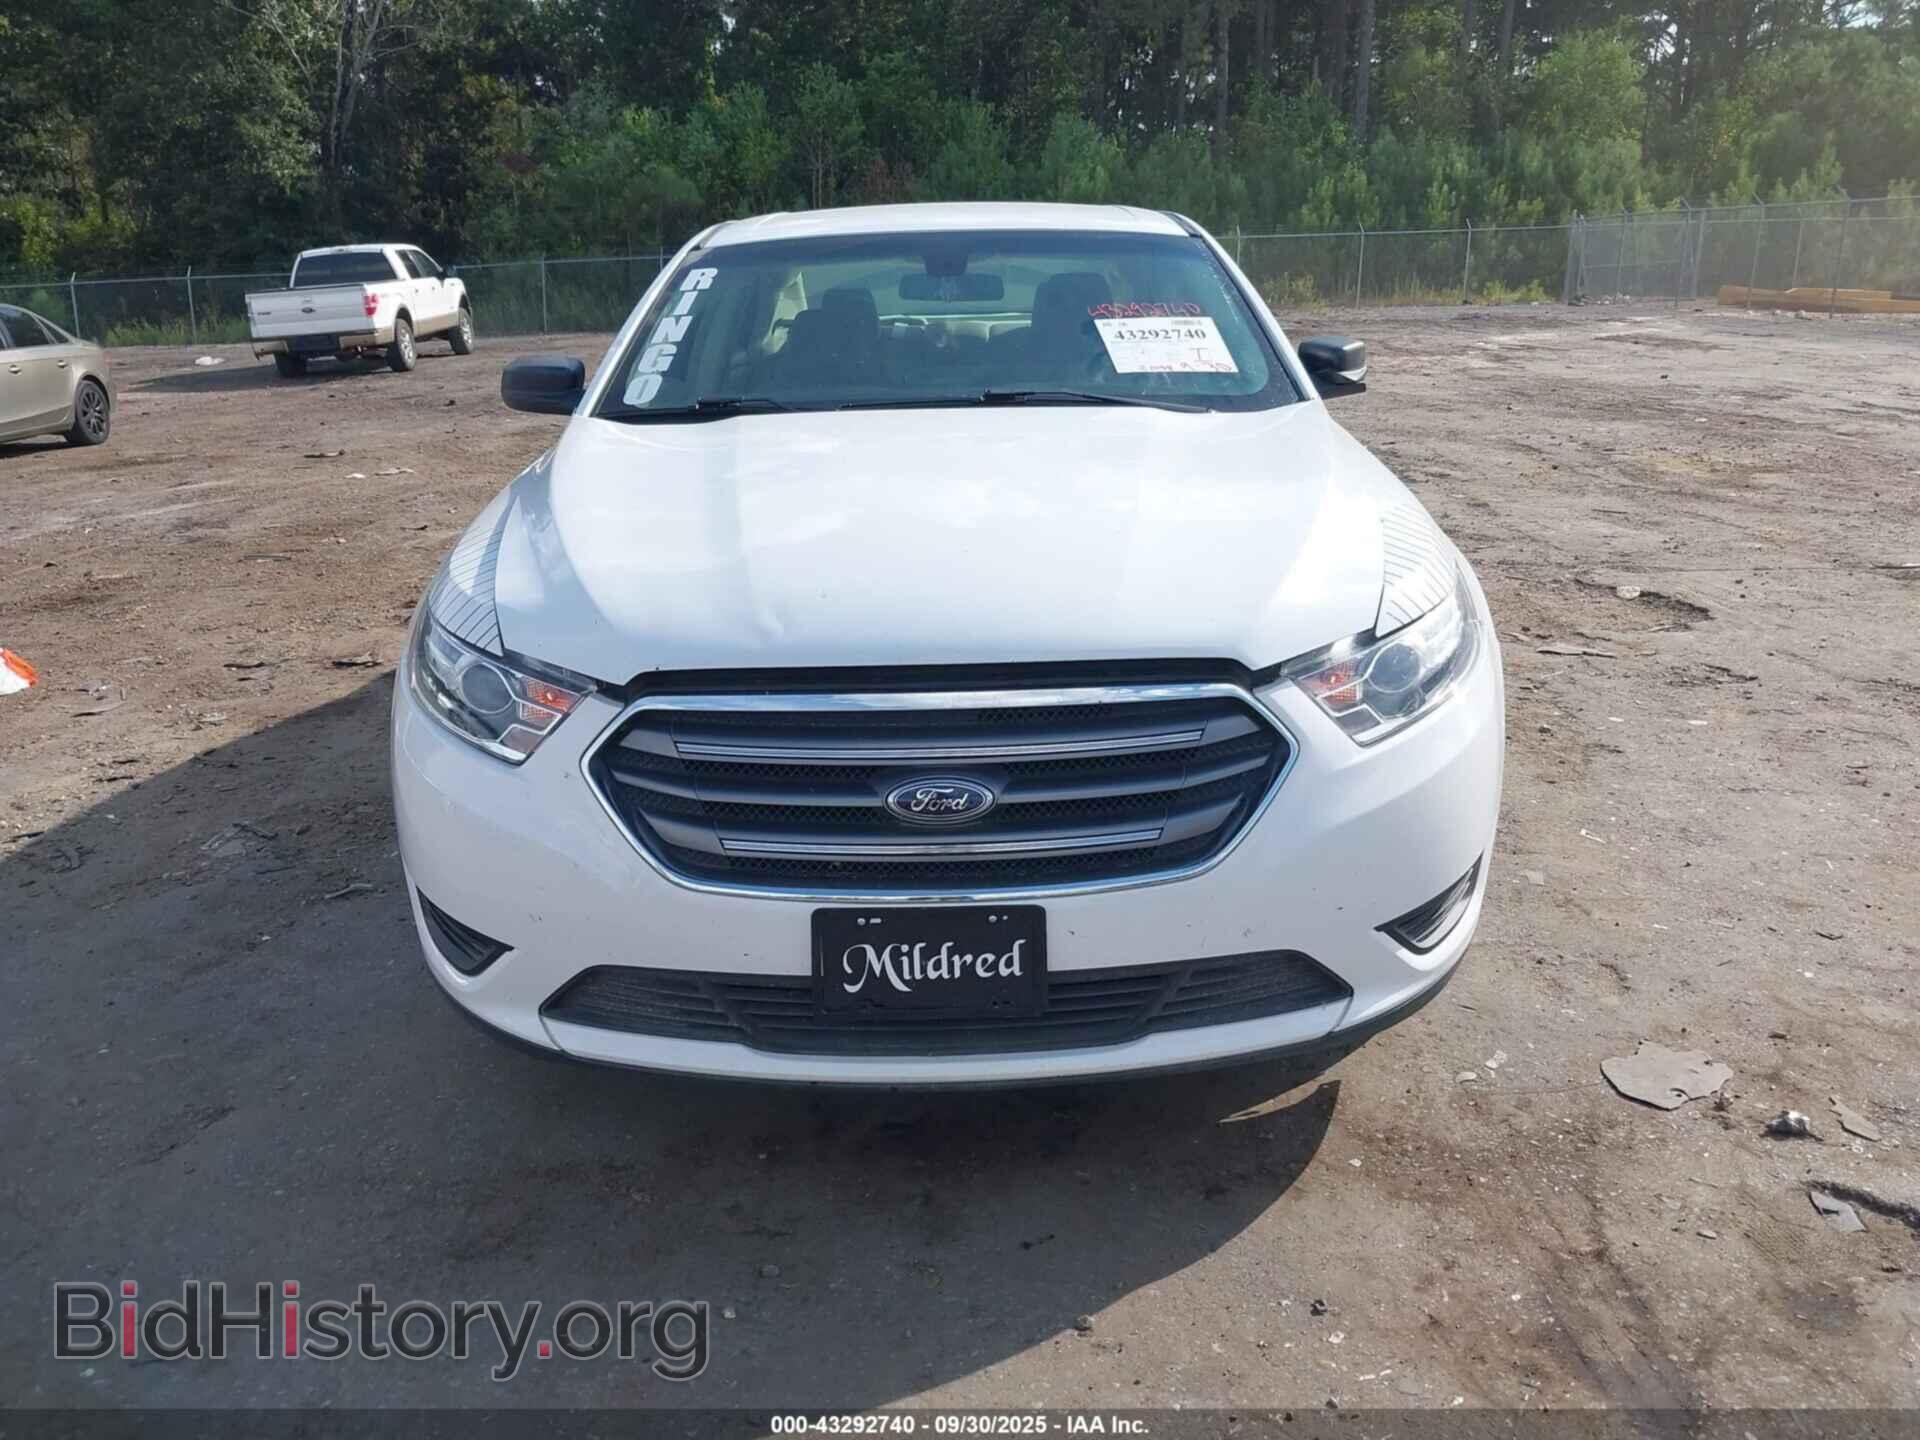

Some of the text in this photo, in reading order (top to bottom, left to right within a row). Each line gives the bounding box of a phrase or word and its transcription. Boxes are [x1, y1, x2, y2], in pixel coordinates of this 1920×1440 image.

[623, 267, 718, 408] RINGO
[1114, 328, 1206, 341] 43292740
[911, 788, 968, 811] Ford
[843, 939, 1026, 993] Mildred
